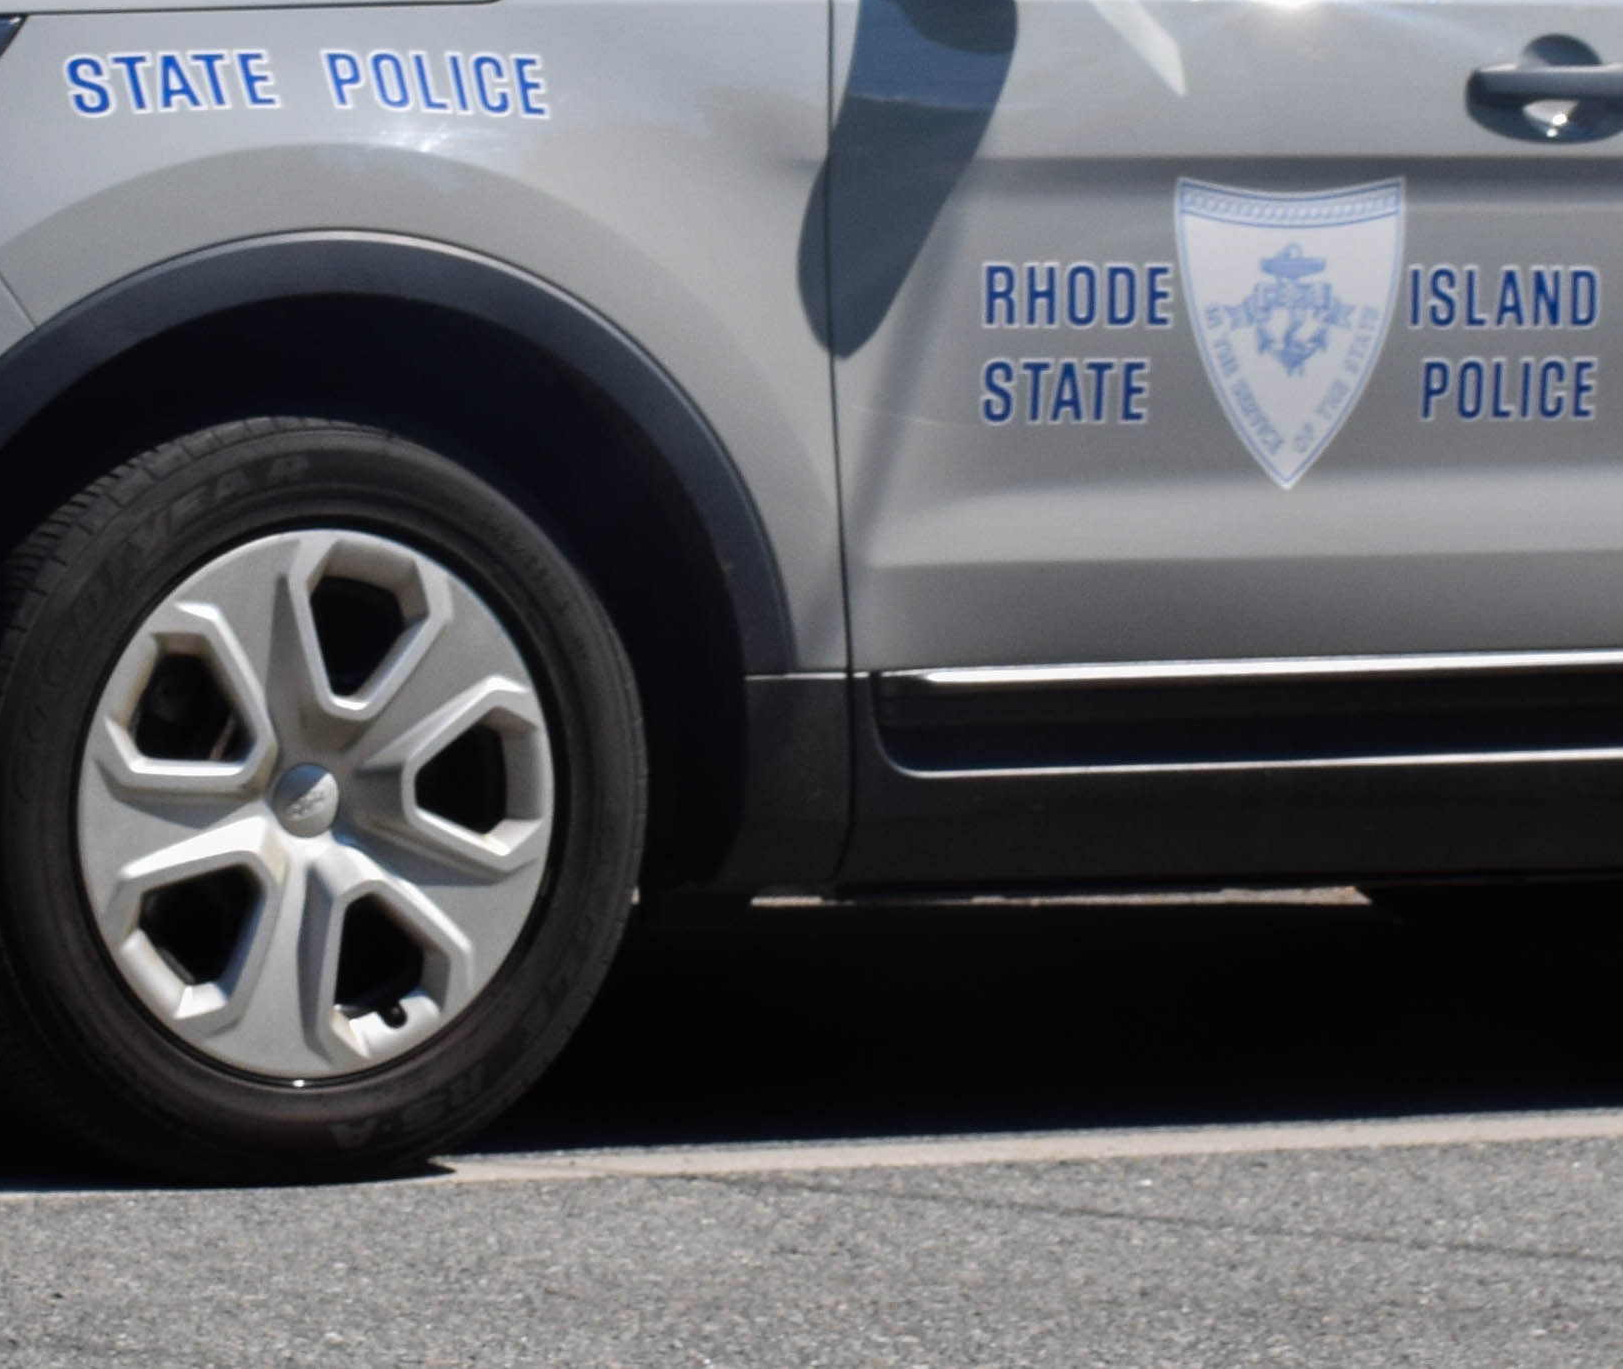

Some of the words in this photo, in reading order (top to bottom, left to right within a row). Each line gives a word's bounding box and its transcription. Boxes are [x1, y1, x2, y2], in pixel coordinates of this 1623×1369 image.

[63, 50, 277, 116] STATE
[323, 50, 549, 118] POLICE
[982, 263, 1173, 329] RHODE
[1408, 266, 1601, 329] ISLAND
[981, 358, 1149, 425] STATE
[1420, 358, 1597, 420] POLICE
